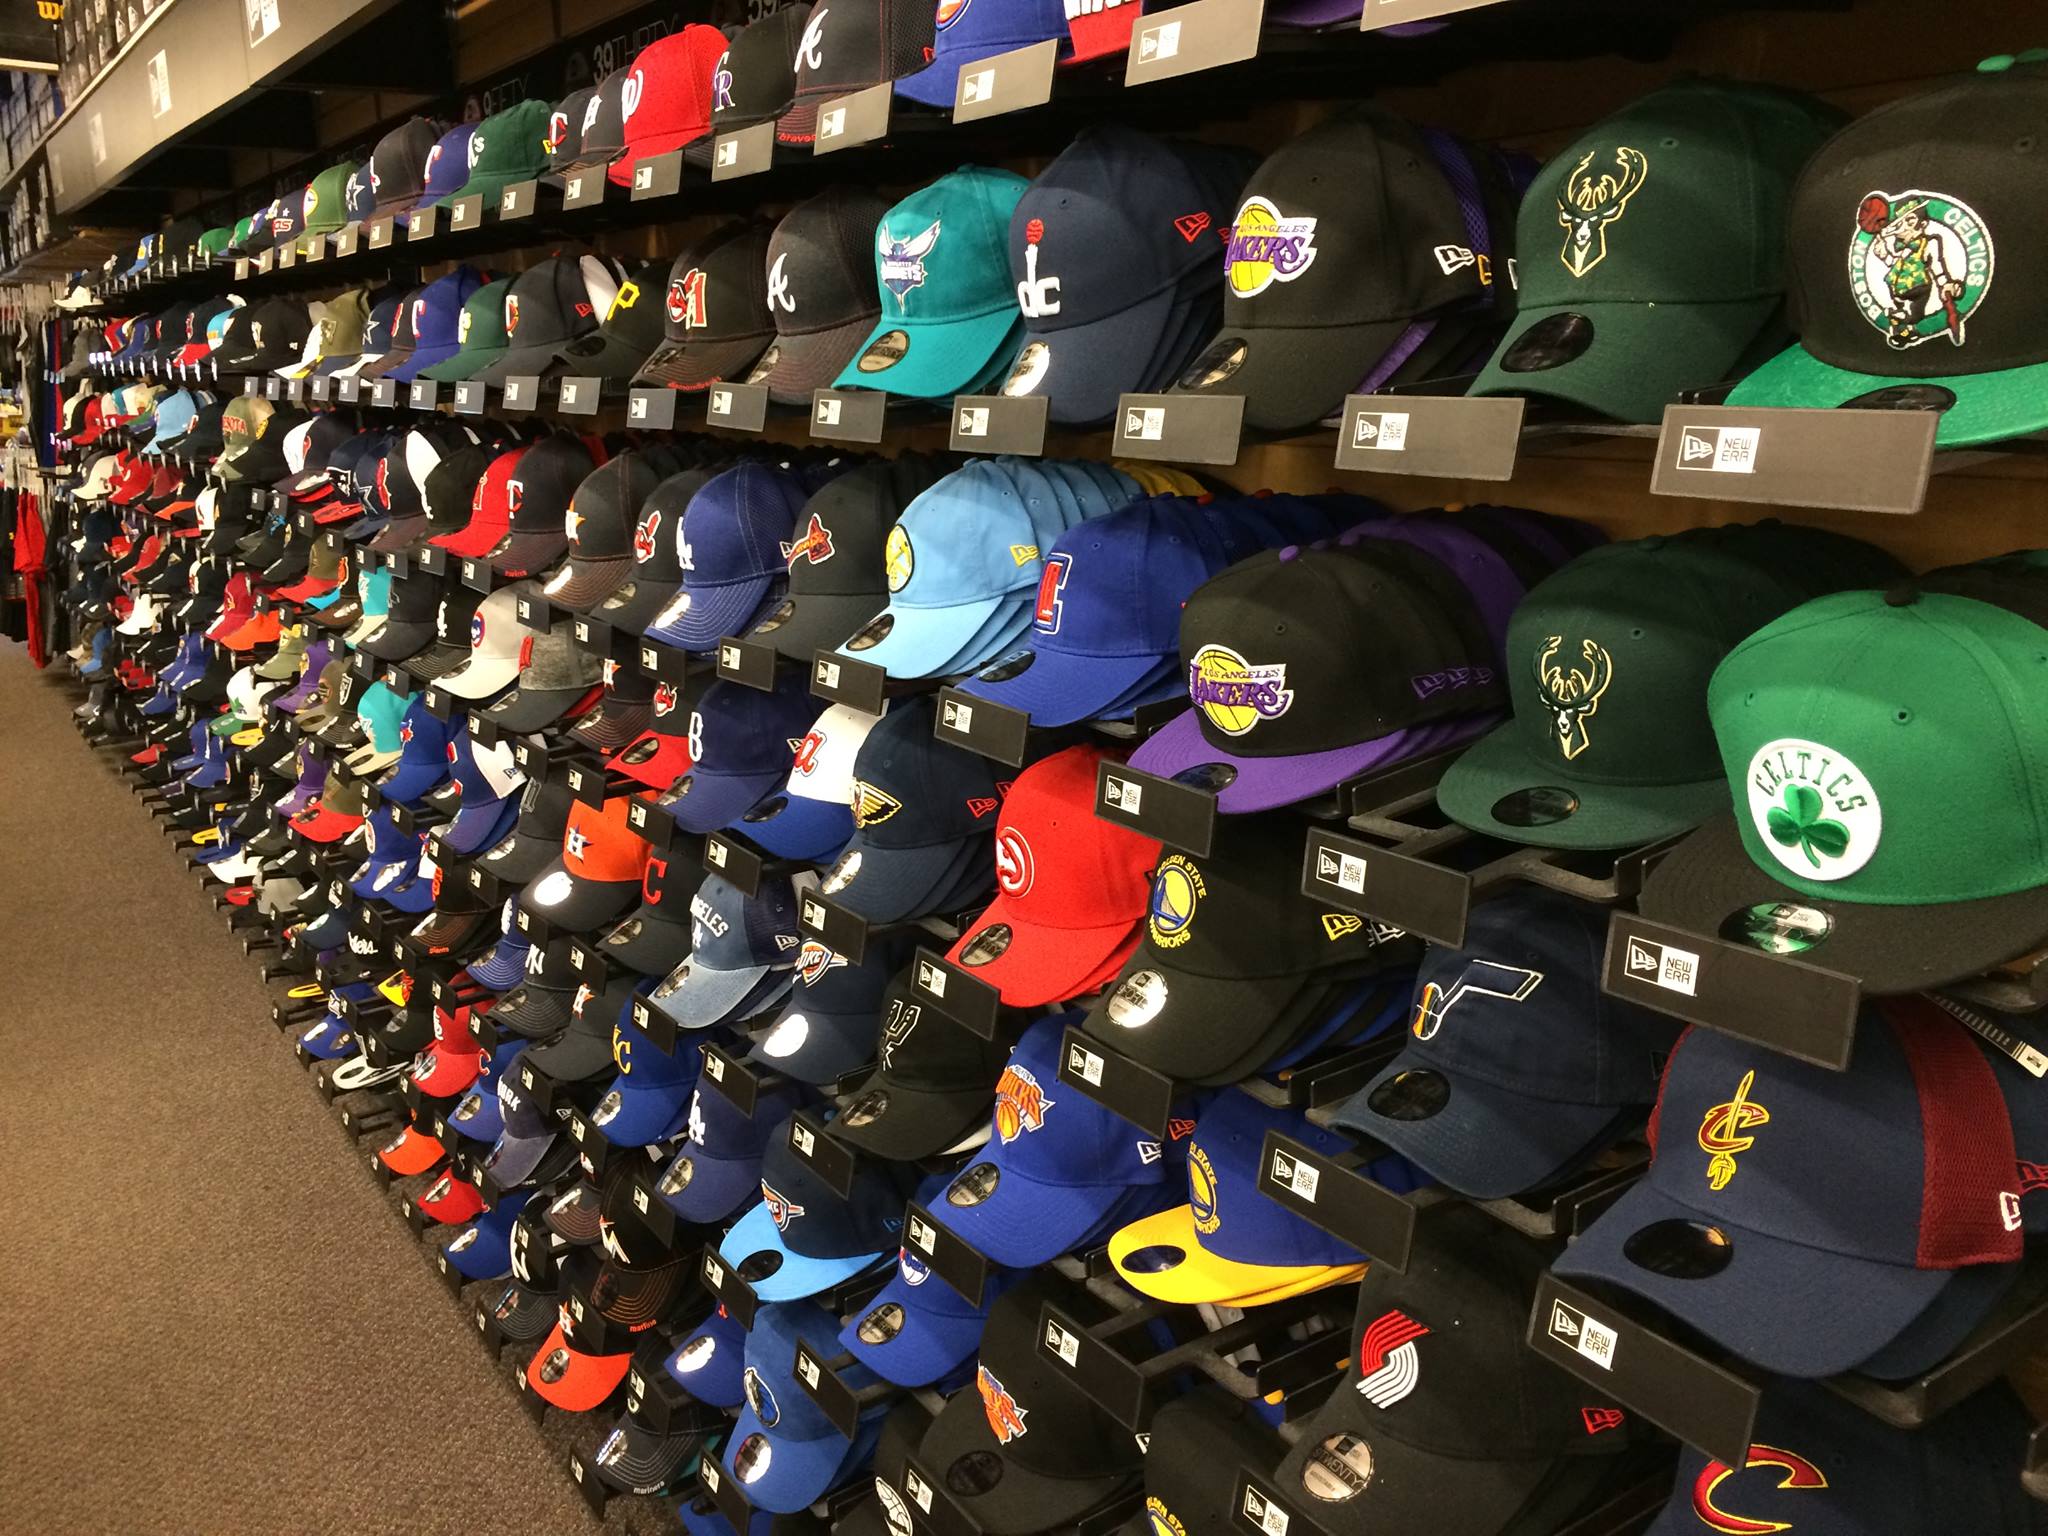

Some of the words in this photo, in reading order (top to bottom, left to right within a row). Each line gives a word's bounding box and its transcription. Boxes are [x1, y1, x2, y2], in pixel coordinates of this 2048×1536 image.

[1254, 224, 1308, 233] ANGELES
[1943, 207, 1988, 288] CELTICS
[1851, 238, 1882, 321] BOSTON
[1724, 438, 1751, 450] NEW
[1721, 450, 1749, 462] ERA
[1221, 669, 1280, 679] ANGELES
[1190, 664, 1290, 717] LAKERS
[689, 711, 703, 762] B
[1755, 751, 1867, 812] CELTICS
[1345, 862, 1361, 875] NEW
[1184, 861, 1207, 898] STATE
[1343, 871, 1360, 884] ERA
[1666, 956, 1692, 972] NEW
[1664, 969, 1690, 985] ERA
[1196, 1149, 1217, 1185] STATE
[1298, 1171, 1315, 1184] NEW
[1296, 1180, 1313, 1193] ERA
[1587, 1327, 1611, 1349] NEW
[1584, 1338, 1608, 1359] ERA
[1269, 1510, 1284, 1525] NEW
